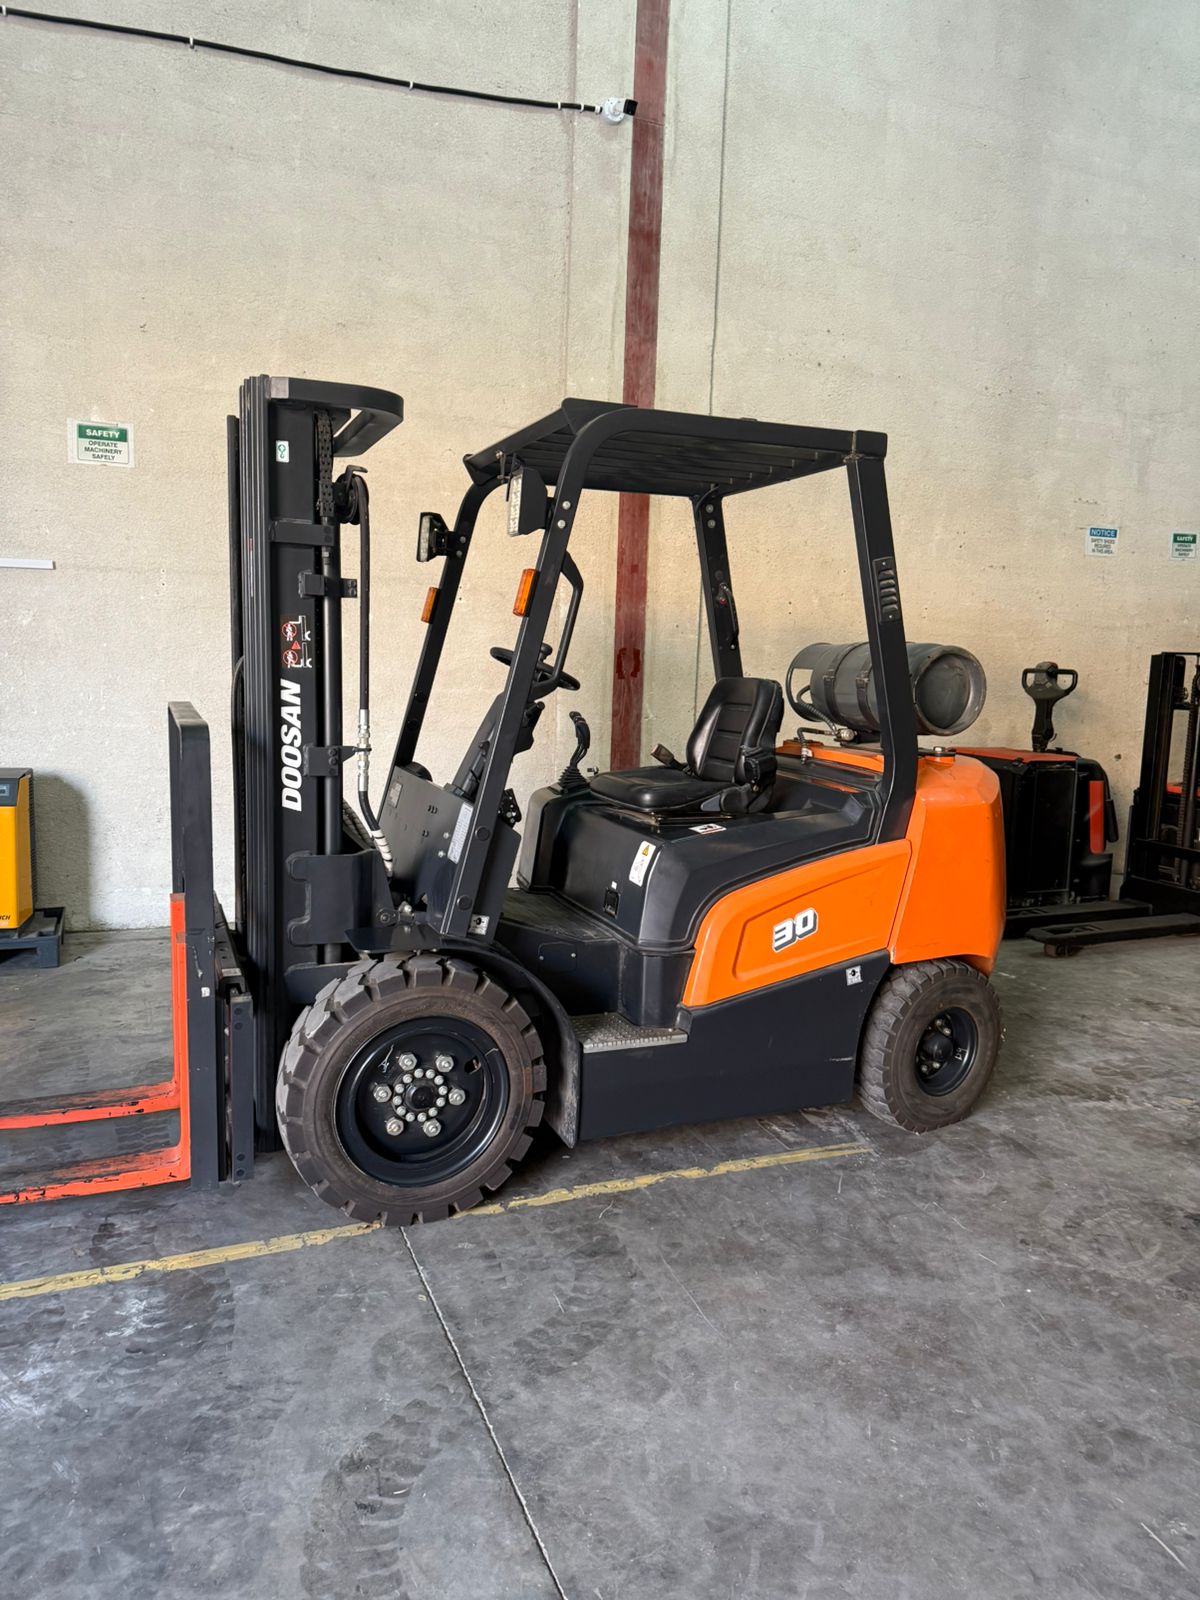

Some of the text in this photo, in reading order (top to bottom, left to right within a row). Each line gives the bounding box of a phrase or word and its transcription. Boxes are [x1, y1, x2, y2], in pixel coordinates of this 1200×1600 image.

[86, 429, 119, 438] SAFETY
[89, 440, 118, 448] OPERATE
[84, 446, 122, 455] MACHINERY
[1091, 528, 1116, 537] NOTICE
[280, 678, 302, 811] DOOSAN
[772, 908, 818, 953] 30
